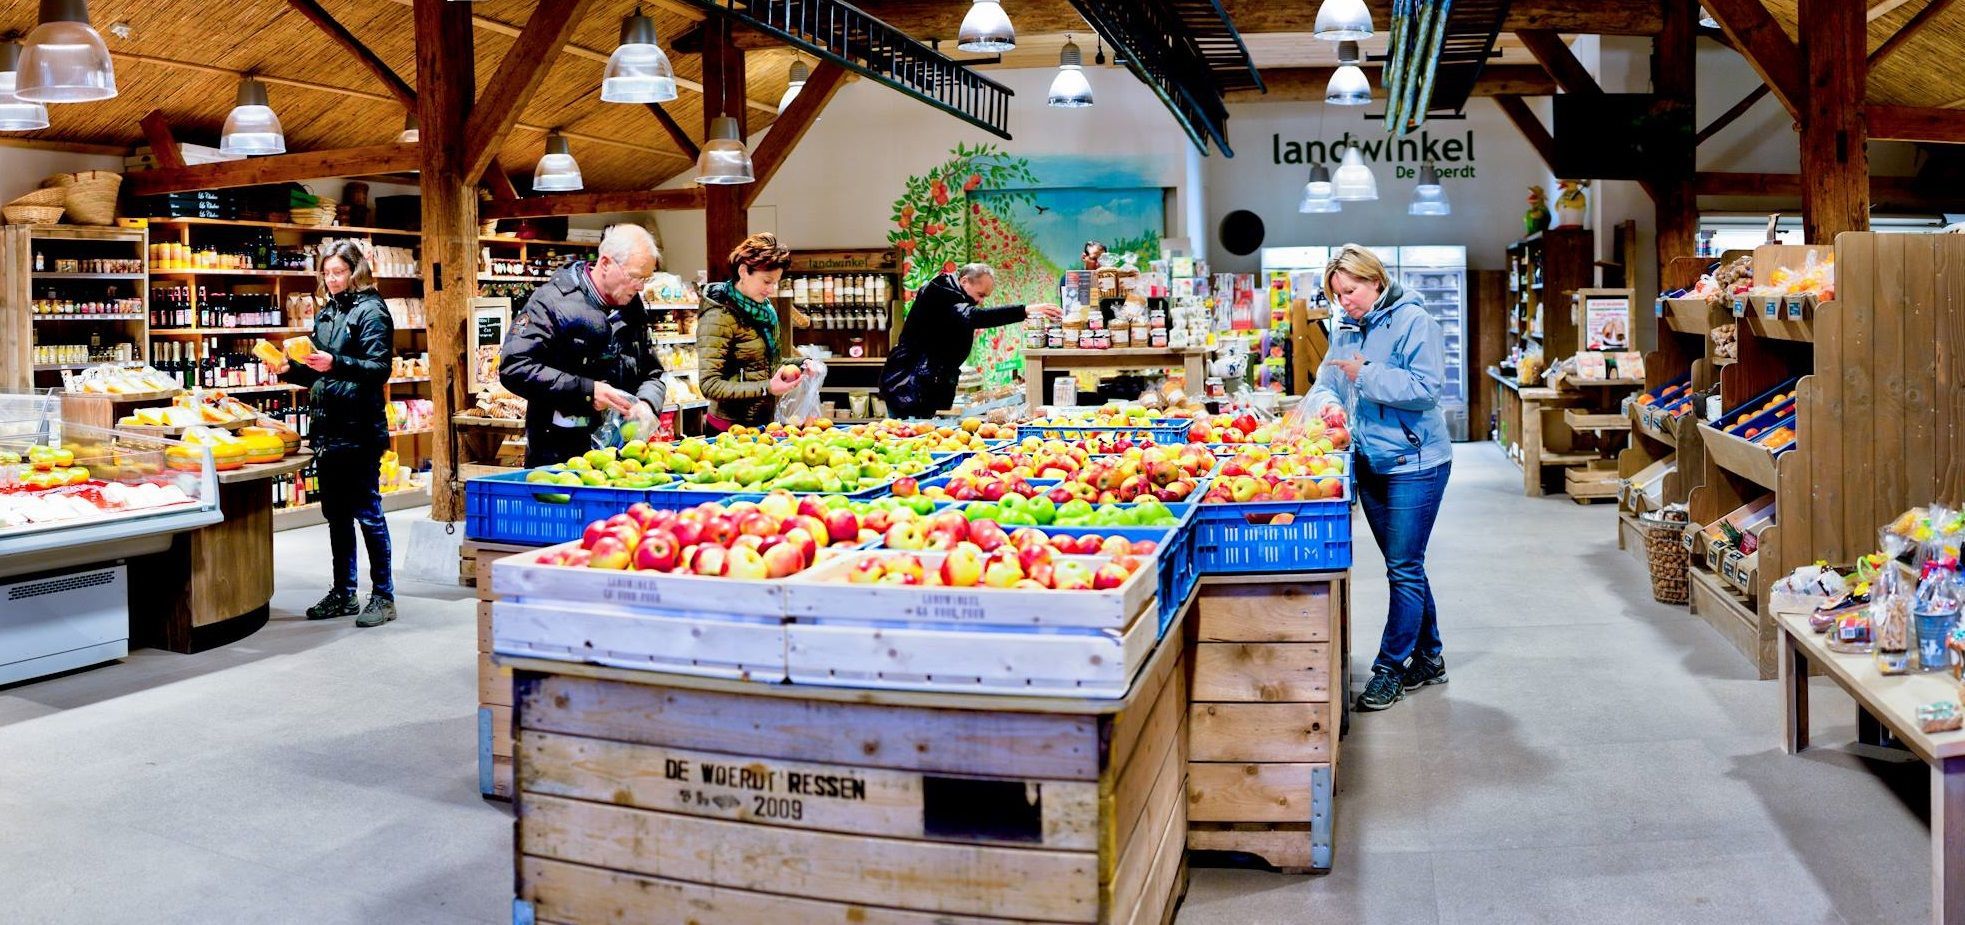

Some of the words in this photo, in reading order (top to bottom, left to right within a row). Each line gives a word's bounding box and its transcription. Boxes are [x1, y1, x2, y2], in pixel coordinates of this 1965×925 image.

[1273, 130, 1476, 164] landwinkel
[1396, 165, 1415, 179] De
[808, 257, 869, 269] landwinkel
[665, 758, 690, 782] DE
[701, 762, 776, 792] WOERDT
[787, 771, 867, 801] RESSEN
[753, 796, 804, 821] 2009
